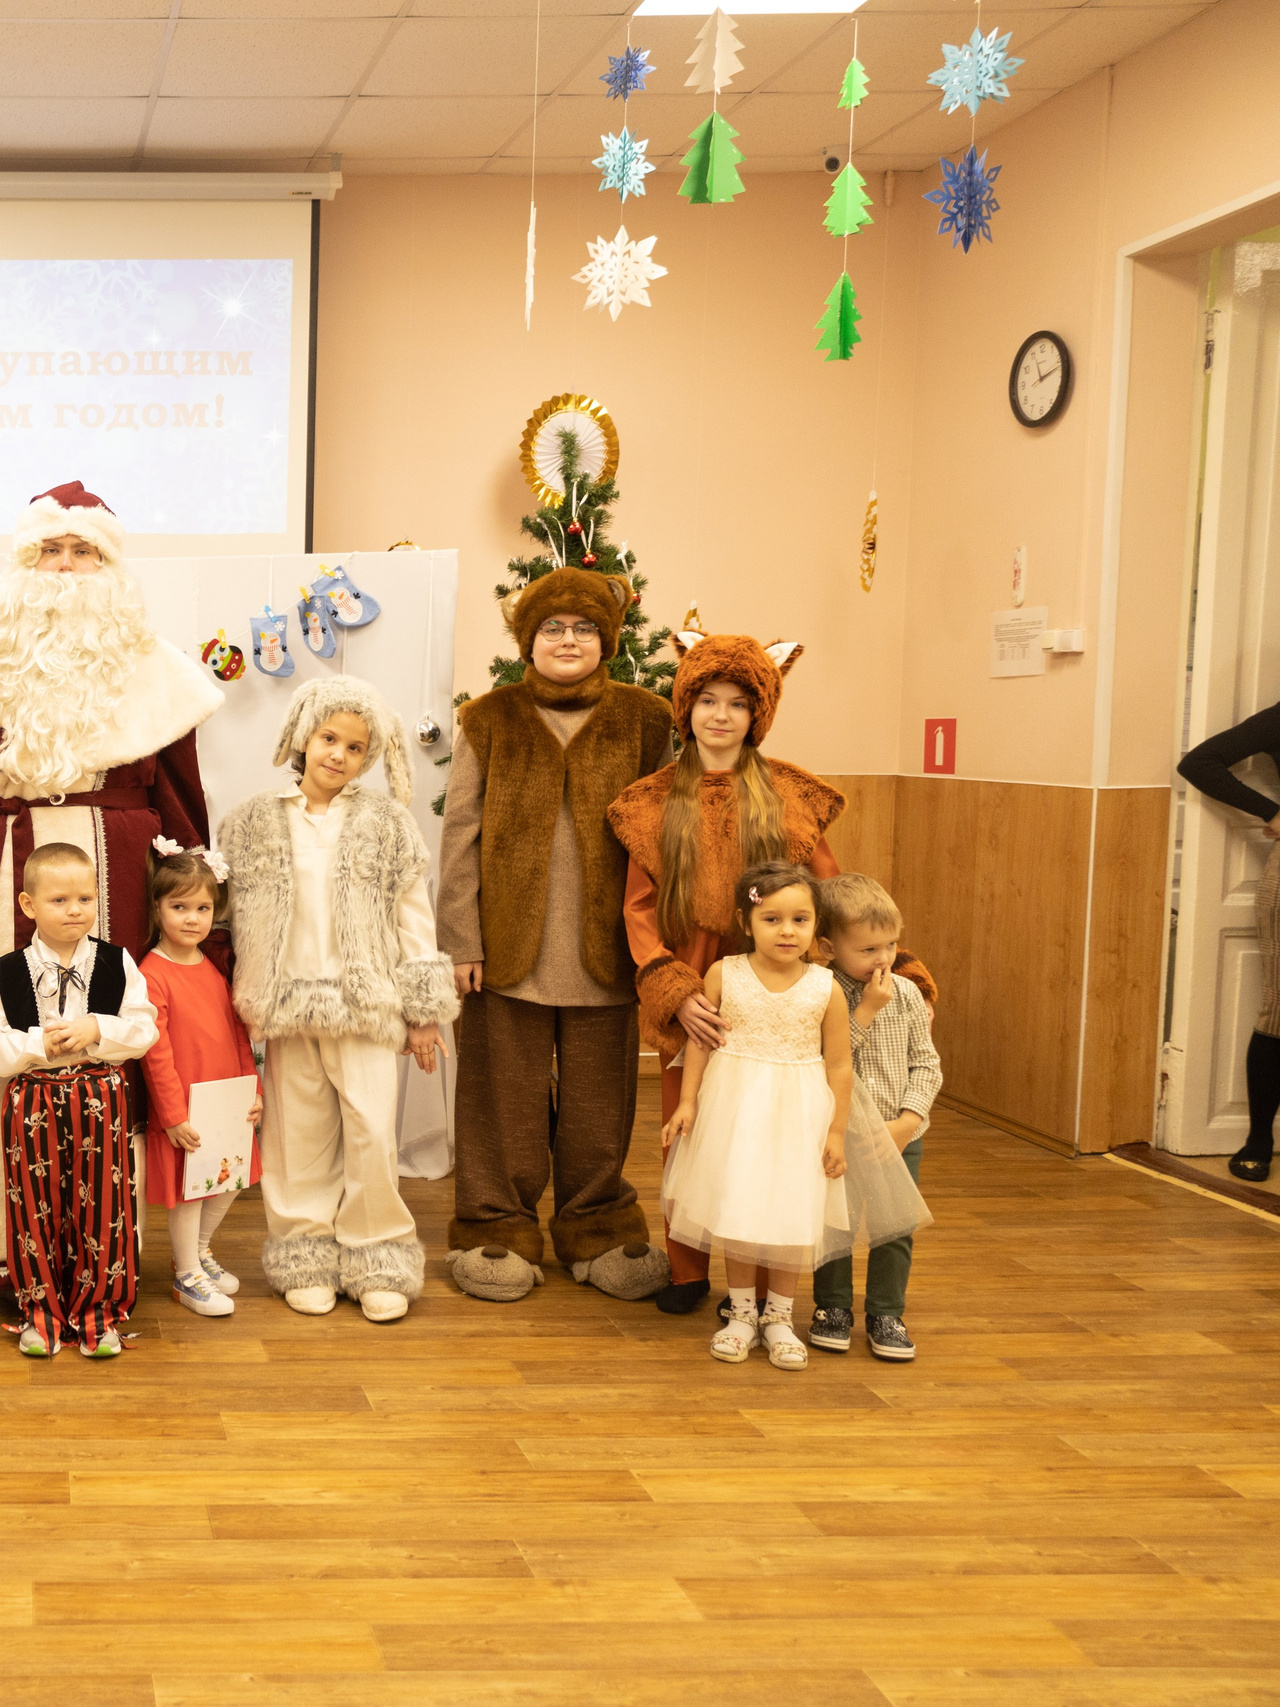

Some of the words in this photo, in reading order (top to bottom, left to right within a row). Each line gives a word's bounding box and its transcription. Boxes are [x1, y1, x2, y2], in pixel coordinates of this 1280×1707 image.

[1039, 343, 1046, 354] 12
[1023, 365, 1030, 375] 10
[1021, 381, 1026, 391] 9
[1023, 395, 1028, 405] 8
[52, 394, 225, 432] годом!
[1030, 404, 1035, 414] 7
[1039, 406, 1044, 416] 6
